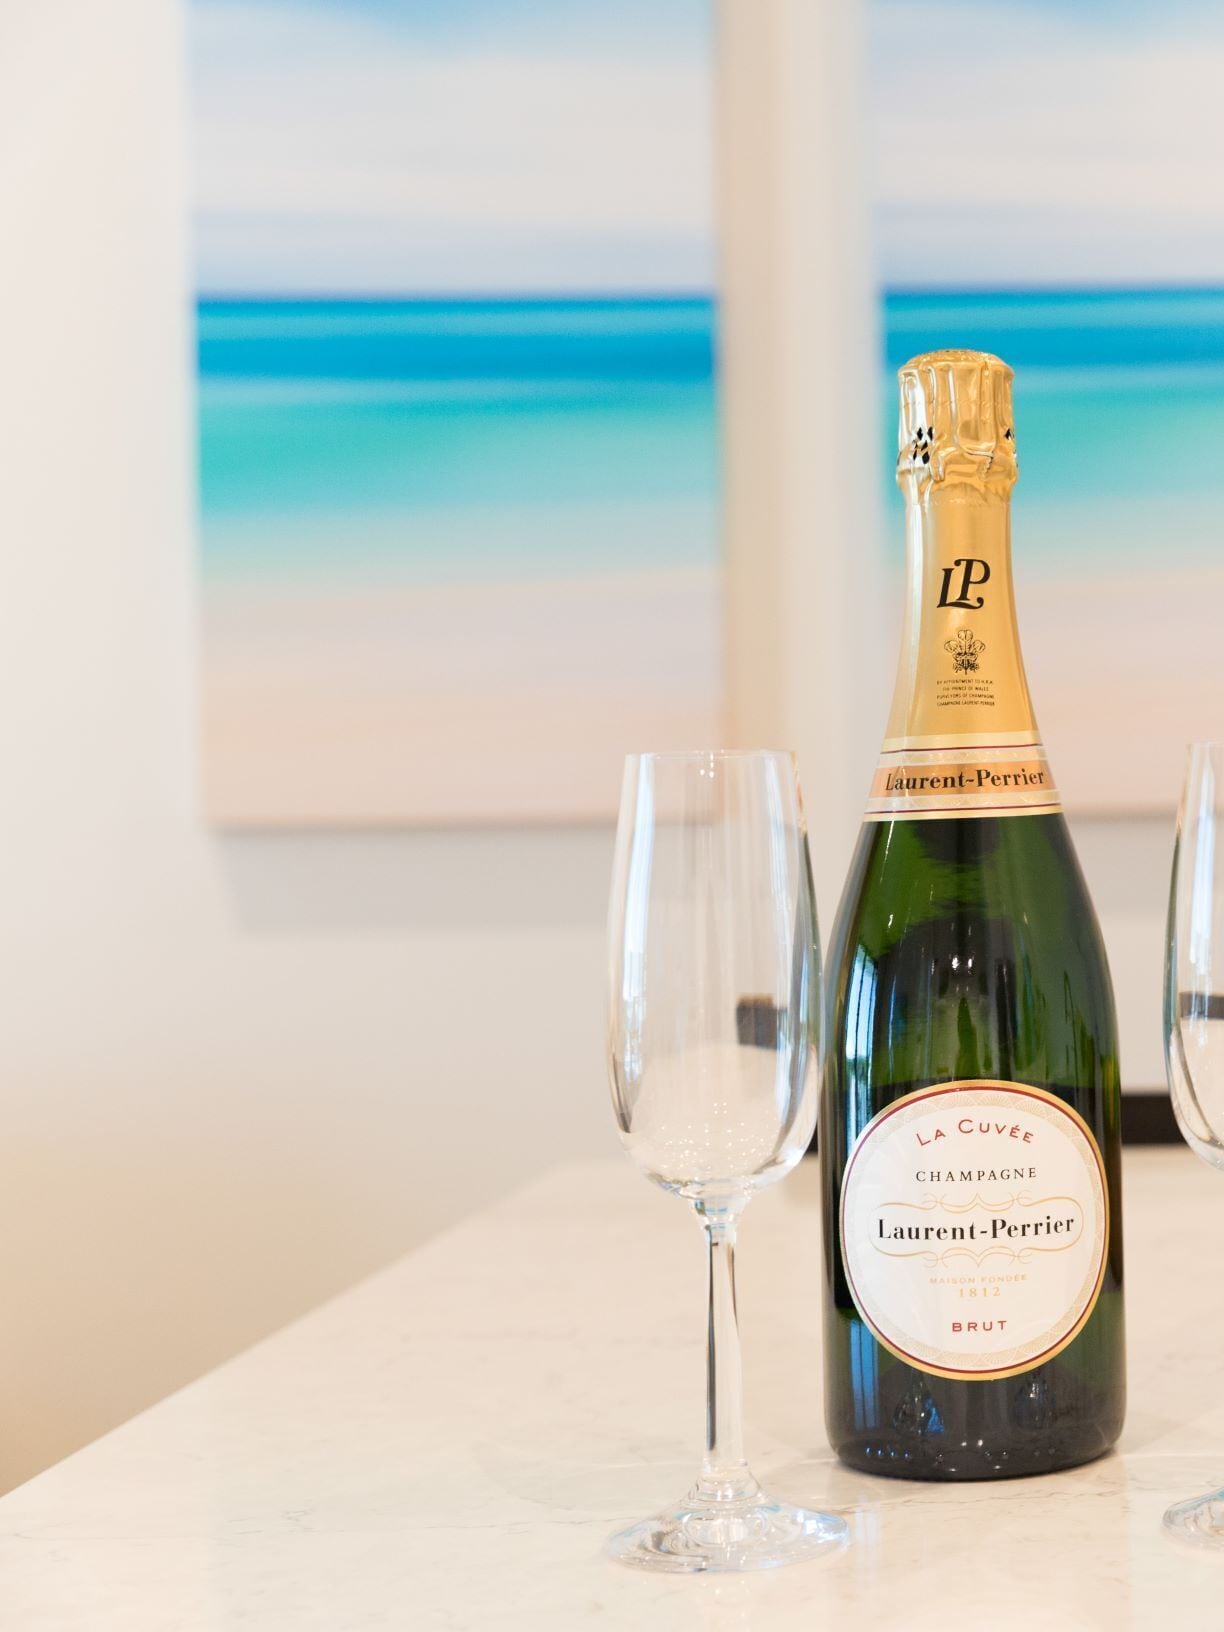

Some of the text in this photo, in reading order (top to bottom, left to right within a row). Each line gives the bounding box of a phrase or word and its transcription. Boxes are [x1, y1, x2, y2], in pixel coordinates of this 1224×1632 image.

[936, 558, 991, 610] LP
[885, 768, 1044, 791] Laurent-Perrier
[916, 1167, 1037, 1182] CHAMPAGNE
[878, 1215, 1075, 1241] Laurent-Perrier
[929, 1274, 1027, 1284] MAISON FONDÉE
[959, 1287, 1001, 1298] 1812
[952, 1320, 1007, 1332] BRUT
